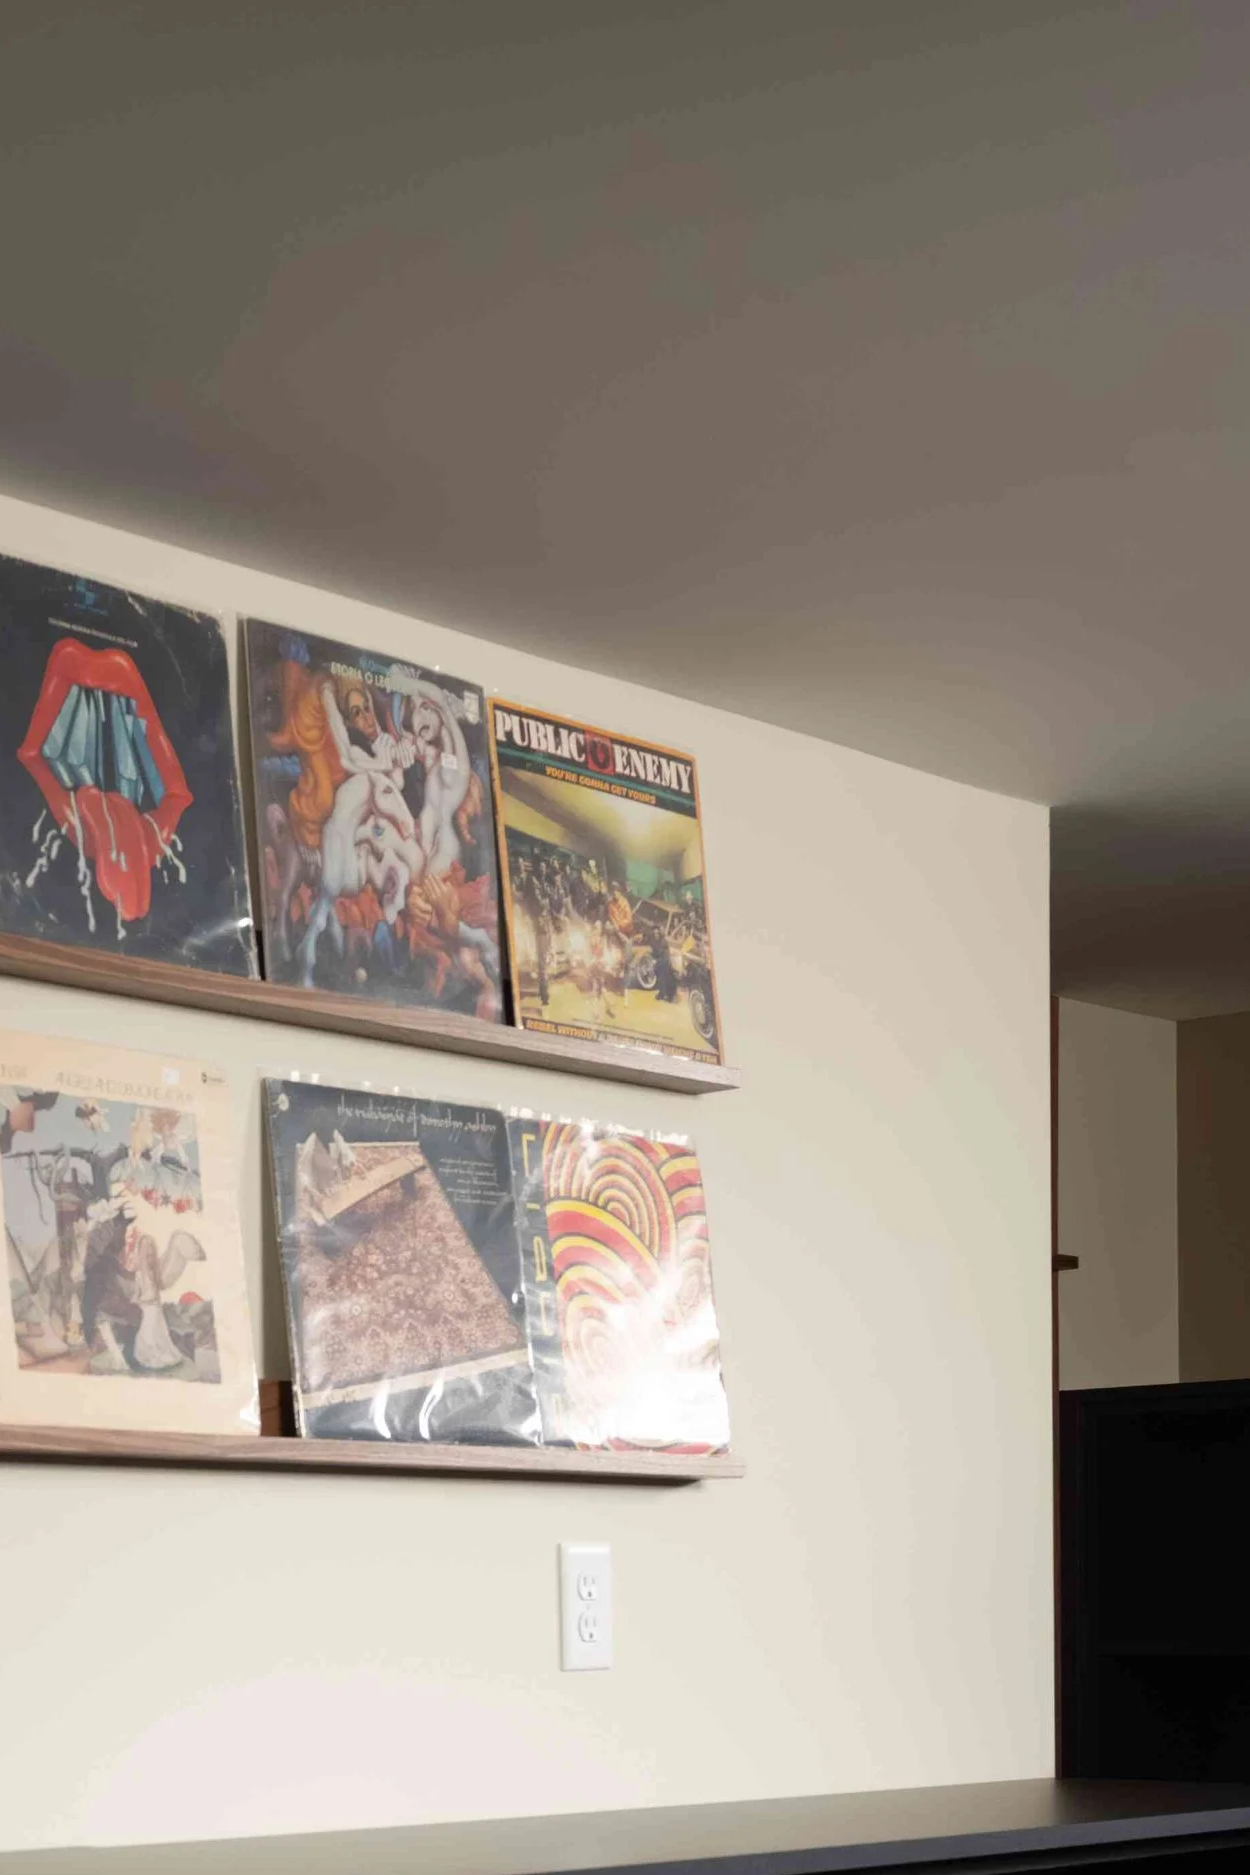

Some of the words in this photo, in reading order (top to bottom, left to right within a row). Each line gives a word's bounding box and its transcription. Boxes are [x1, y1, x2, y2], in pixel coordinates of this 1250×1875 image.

[494, 709, 586, 763] PUBLIC
[614, 744, 692, 794] ENEMY
[546, 766, 578, 781] YOU'RE
[580, 775, 610, 792] GONNA
[611, 783, 627, 797] GET
